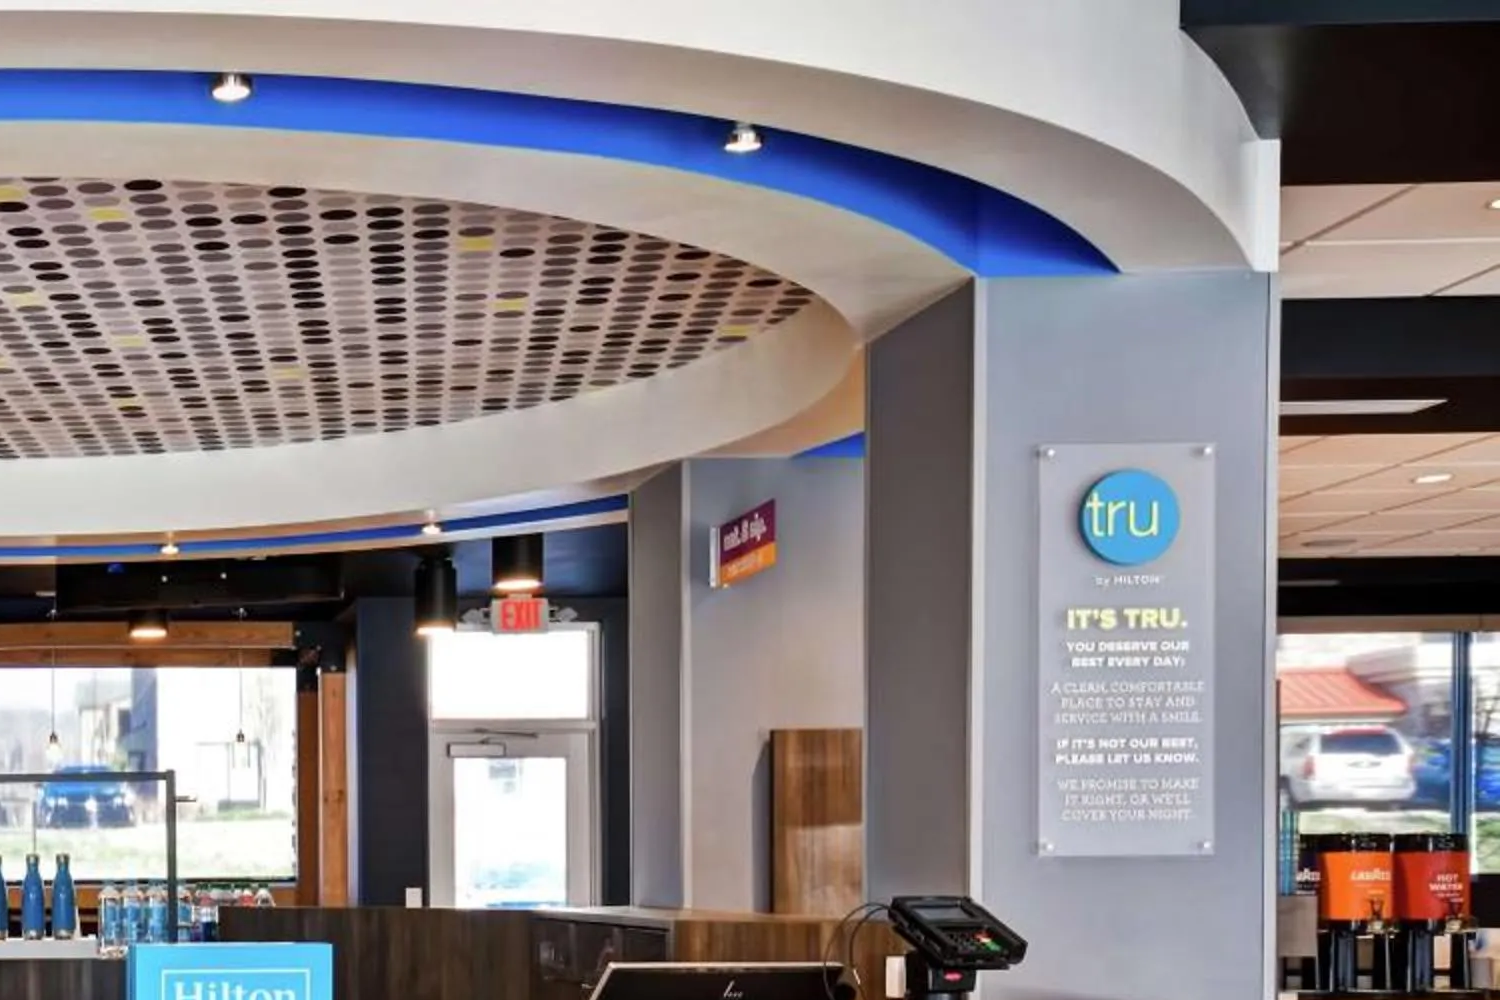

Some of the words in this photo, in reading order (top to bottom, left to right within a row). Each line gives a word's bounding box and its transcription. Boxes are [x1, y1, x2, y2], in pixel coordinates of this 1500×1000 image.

[1086, 489, 1159, 538] tru
[1114, 574, 1160, 585] HILTON
[501, 600, 543, 630] EXIT
[1067, 608, 1118, 630] IT'S
[1123, 607, 1189, 630] TRU.
[1066, 641, 1096, 653] YOU
[1098, 641, 1158, 653] DESERVE
[1160, 640, 1190, 652] OUR
[1071, 657, 1105, 668] BEST
[1107, 656, 1151, 668] EVERY
[1051, 682, 1062, 694] A
[1110, 680, 1205, 693] COMFORTABLE
[1061, 697, 1102, 709] PLACE
[1107, 697, 1126, 708] TO
[1129, 697, 1162, 708] STAY
[1165, 696, 1195, 707] AND
[1056, 713, 1109, 725] SERVICE
[1110, 713, 1146, 724] WITH
[1148, 713, 1159, 723] A
[1057, 739, 1069, 749] IF
[1071, 738, 1096, 749] IT'S
[1098, 738, 1127, 749] NOT
[1129, 738, 1159, 749] OUR
[1055, 754, 1104, 765] PLEASE
[1107, 754, 1131, 764] LET
[1133, 753, 1152, 764] US
[1155, 753, 1200, 764] KNOW.
[1436, 873, 1460, 883] HOT
